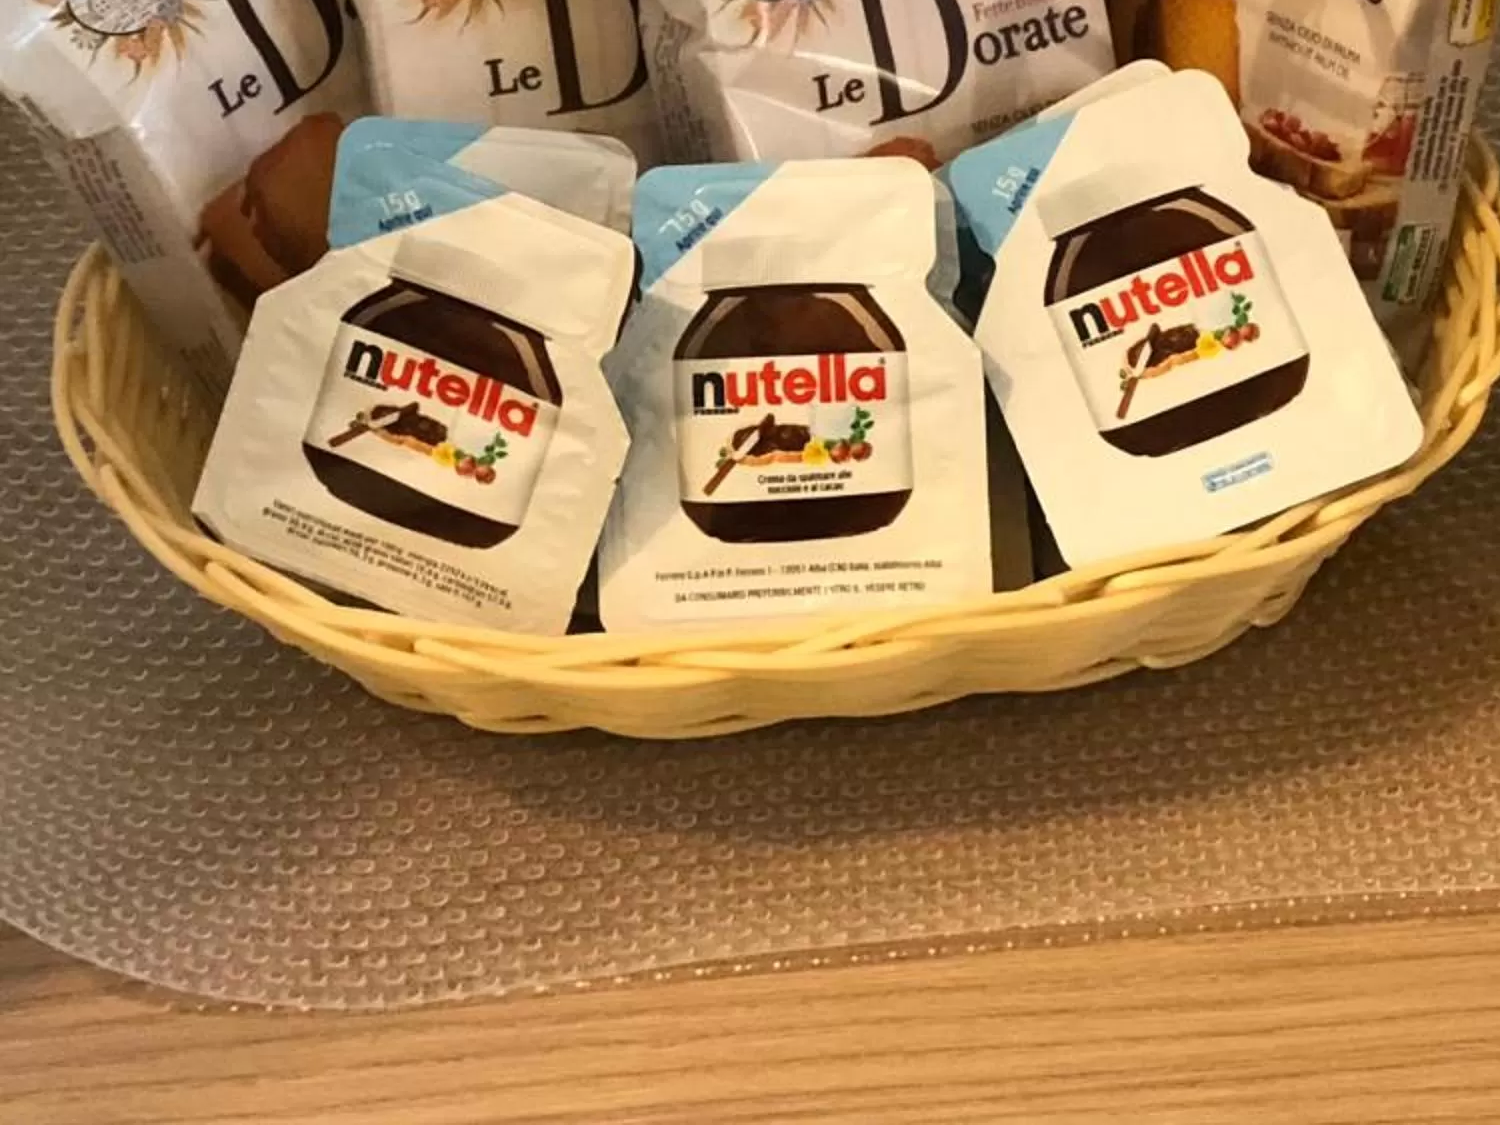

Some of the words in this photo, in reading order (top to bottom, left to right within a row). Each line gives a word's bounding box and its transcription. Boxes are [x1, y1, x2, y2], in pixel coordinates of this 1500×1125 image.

[209, 73, 261, 117] Le
[484, 59, 543, 98] Le
[813, 74, 865, 112] Le
[1068, 246, 1254, 341] nutella
[344, 339, 541, 439] nutella
[692, 354, 887, 409] nutella
